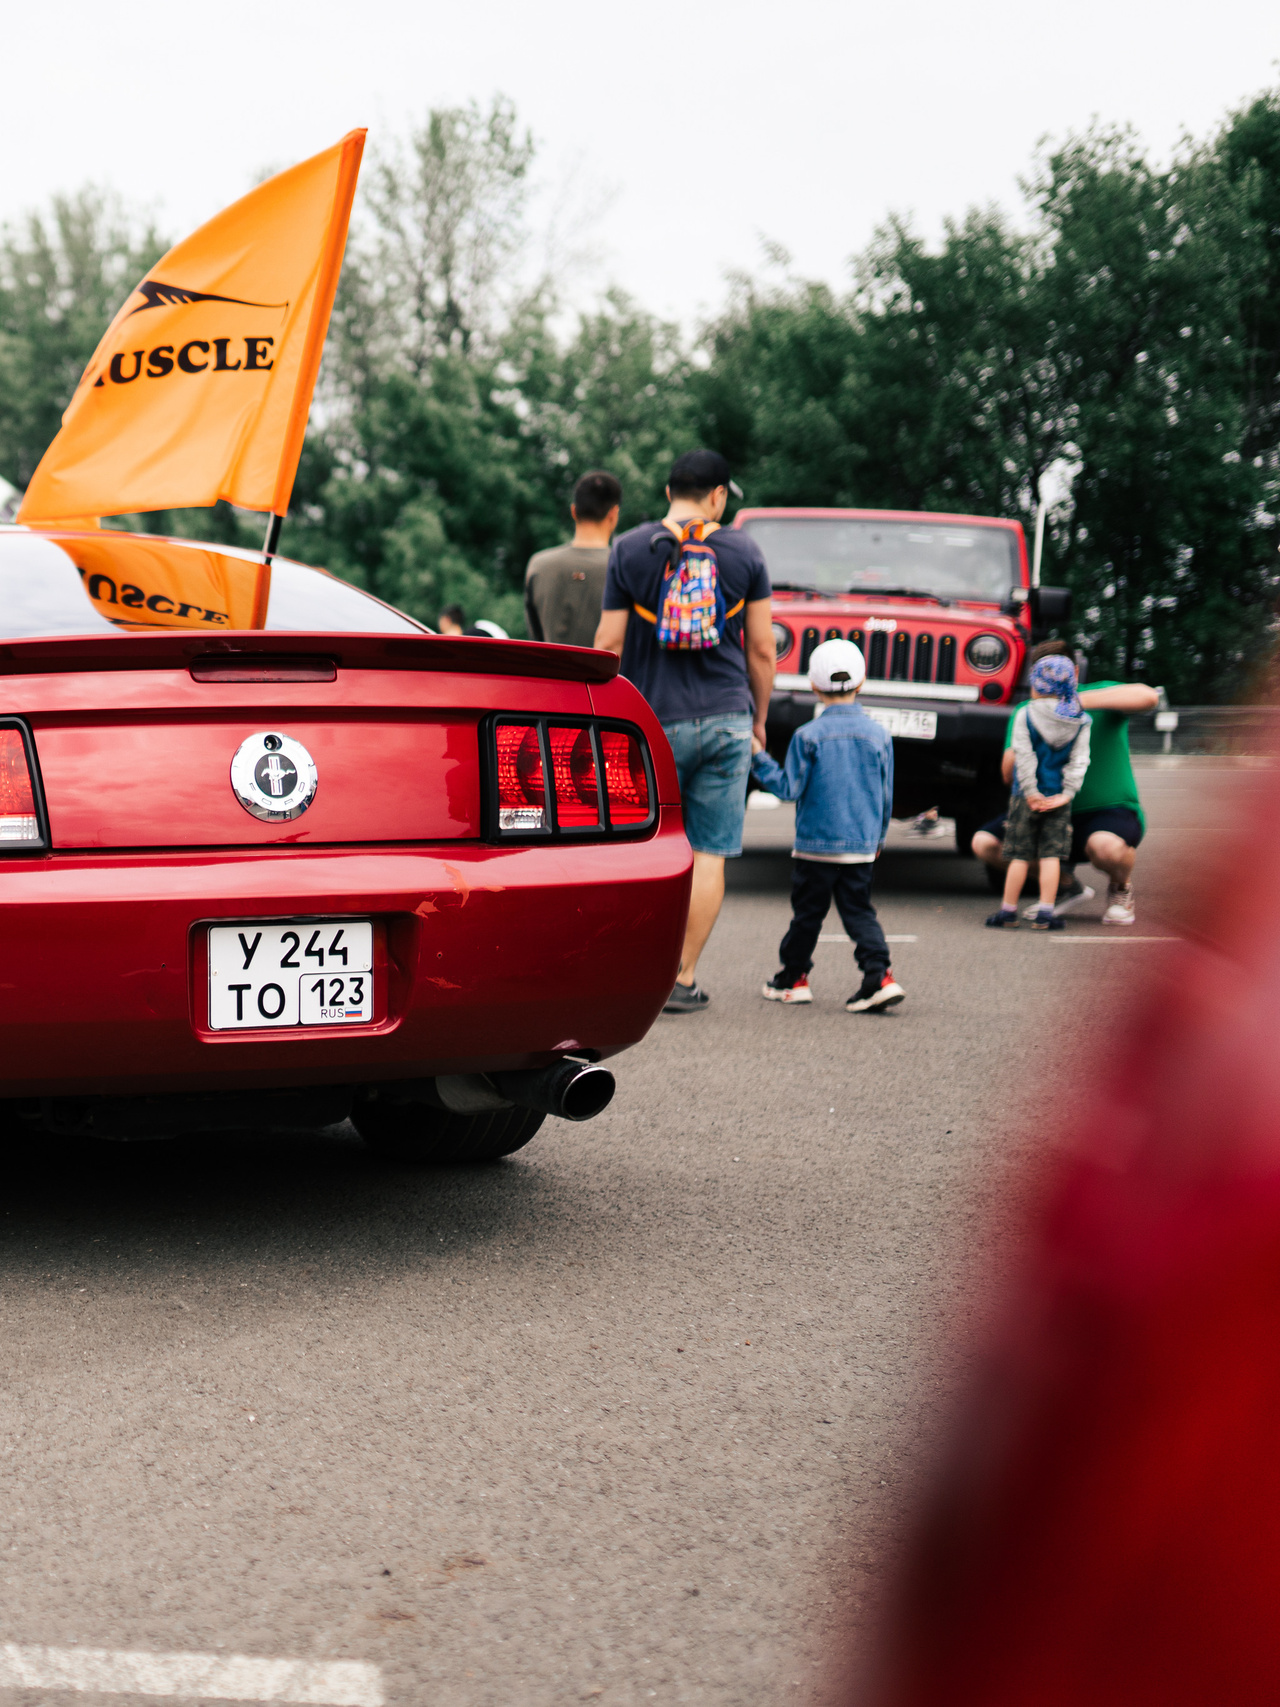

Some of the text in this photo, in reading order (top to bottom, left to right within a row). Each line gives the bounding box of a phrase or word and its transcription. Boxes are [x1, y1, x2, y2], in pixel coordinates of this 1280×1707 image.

[93, 337, 275, 387] USCLE
[280, 929, 348, 968] 244
[311, 977, 364, 1007] 123
[320, 1008, 344, 1018] RUS
